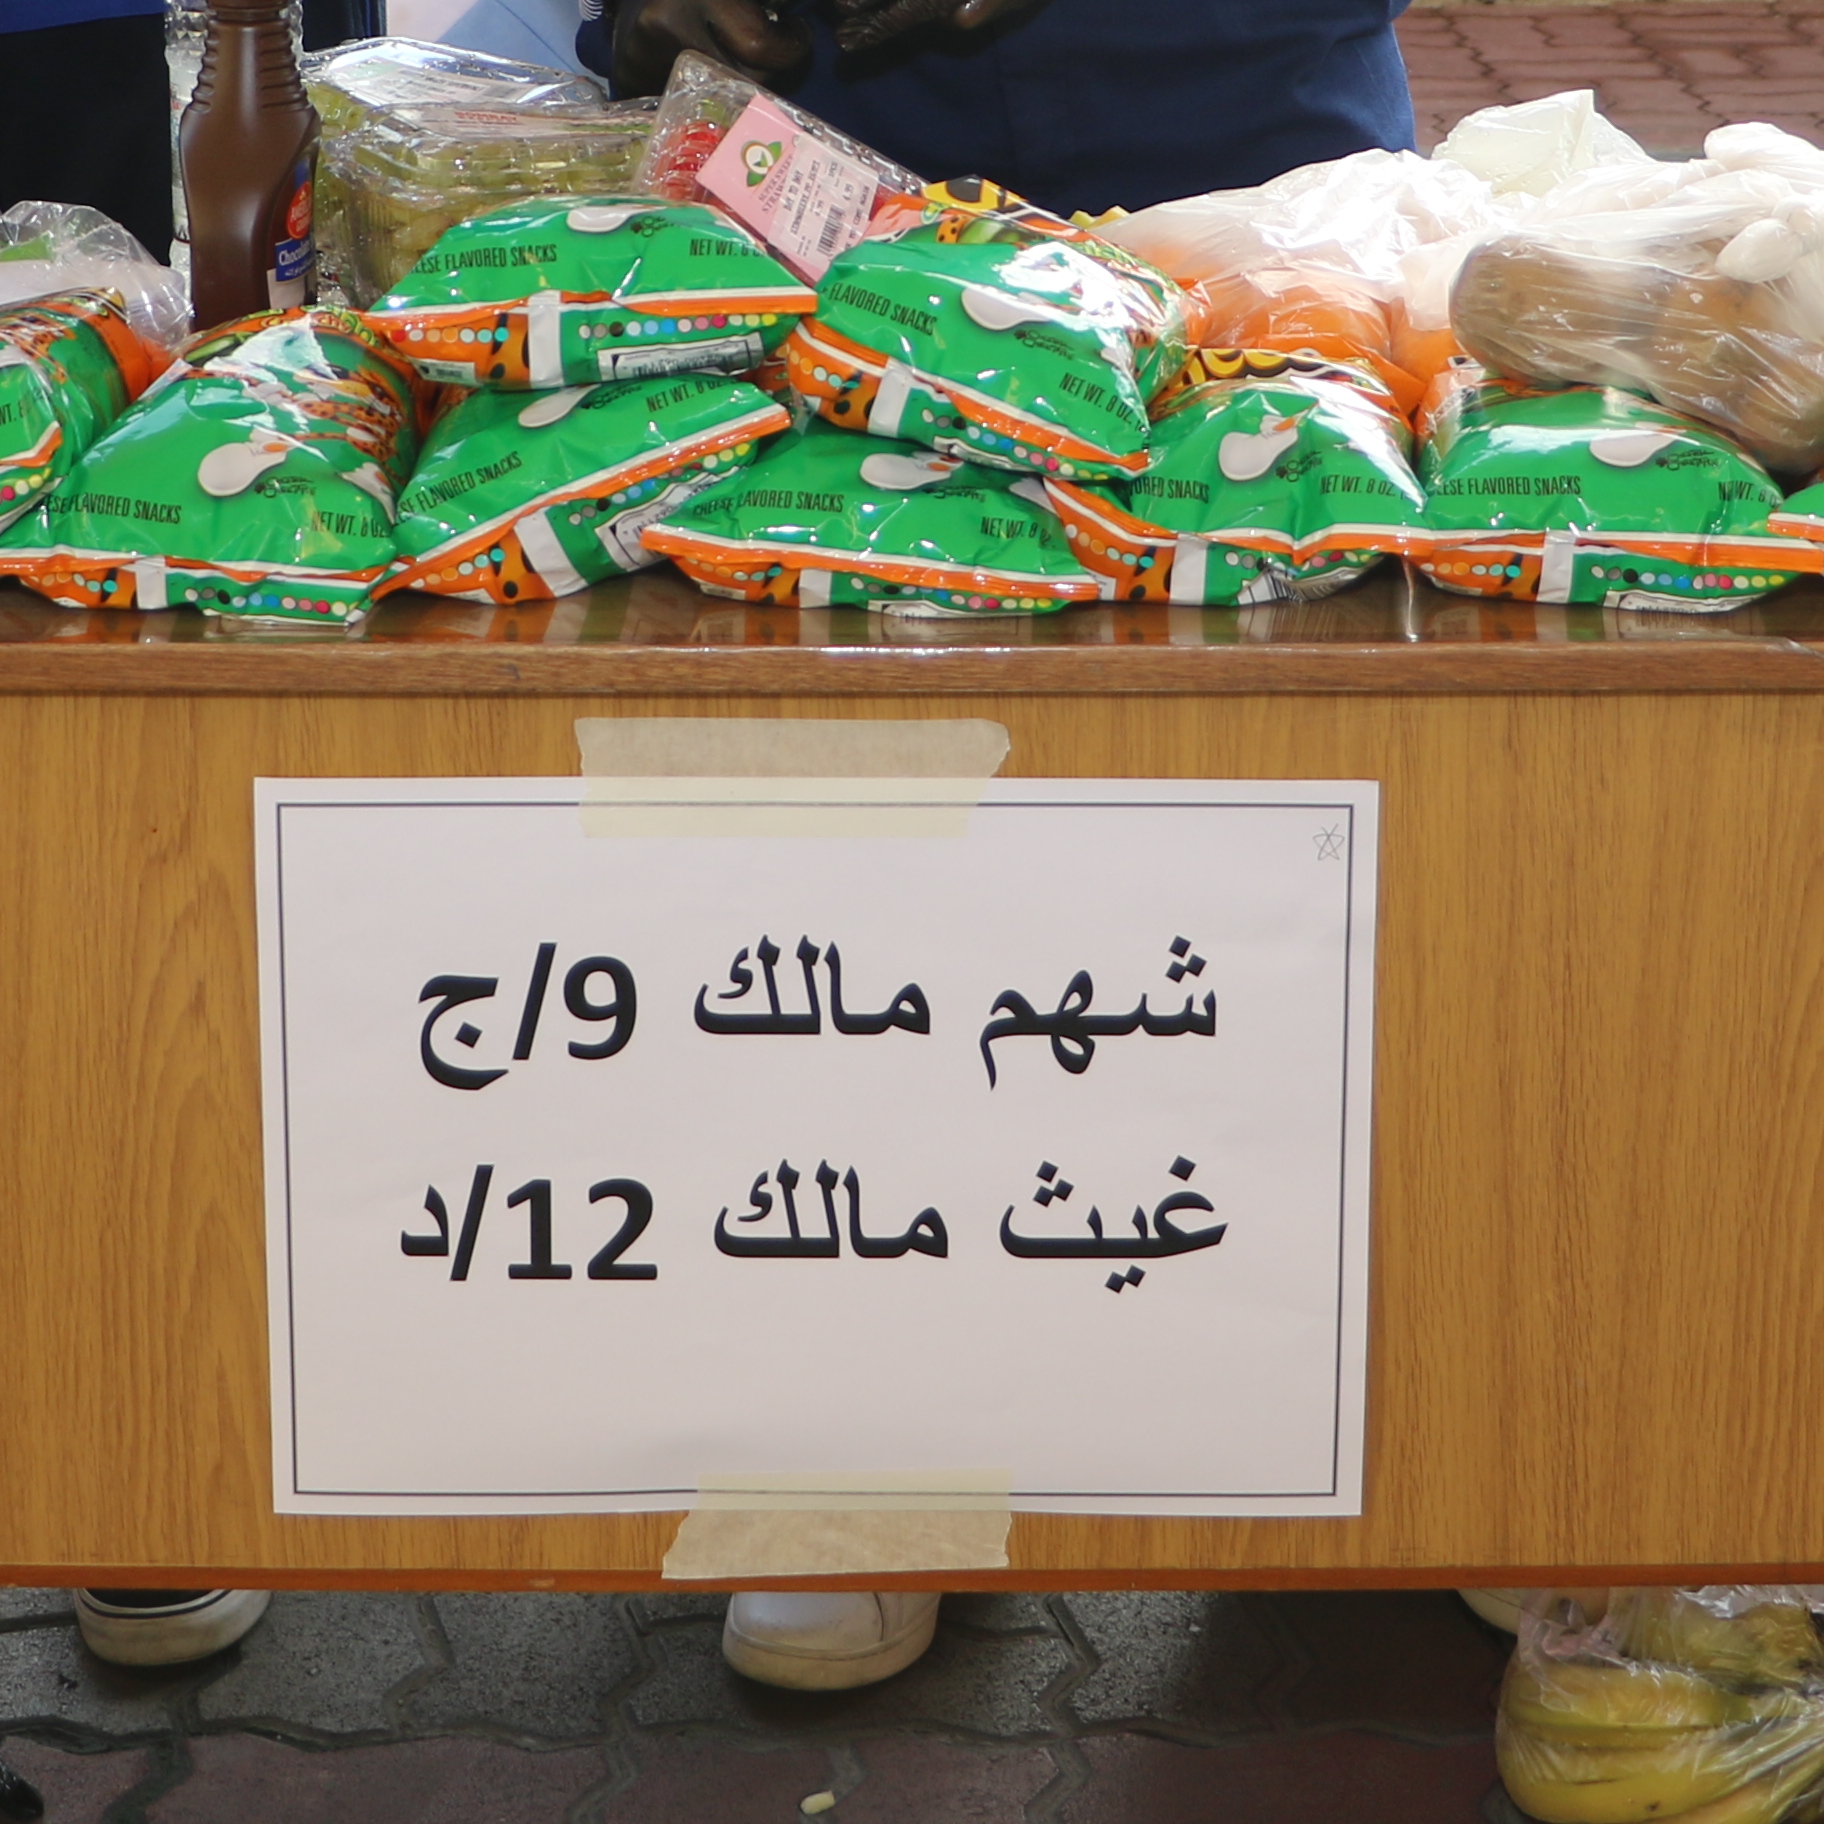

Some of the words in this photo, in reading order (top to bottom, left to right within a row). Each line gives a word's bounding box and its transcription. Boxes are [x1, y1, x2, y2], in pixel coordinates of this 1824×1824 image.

[759, 179, 777, 202] SUPER
[775, 155, 793, 180] SWEET
[445, 247, 506, 269] FLAVORED
[510, 244, 557, 266] SNACKS
[689, 238, 712, 256] NET
[716, 240, 737, 256] WT.
[829, 282, 891, 317] FLAVORED
[890, 303, 938, 336] SNACKS
[646, 390, 669, 413] NET
[669, 383, 695, 404] WT.
[1059, 372, 1086, 396] NET
[1083, 382, 1106, 408] WT.
[1106, 395, 1118, 412] 8
[415, 471, 476, 512] FLAVORED
[476, 451, 523, 484] SNACKS
[1167, 478, 1210, 504] SNACKS
[1321, 474, 1340, 494] NET
[1341, 476, 1362, 493] WT.
[1366, 478, 1375, 494] 8
[1377, 480, 1396, 497] OZ.
[1468, 477, 1530, 495] FLAVORED
[1534, 475, 1581, 496] SNACKS
[1736, 480, 1754, 501] WT.
[68, 493, 130, 517] FLAVORED
[133, 499, 182, 525] SNACKS
[693, 497, 735, 517] CHEESE
[796, 491, 844, 513] SNACKS
[311, 510, 334, 533] NET
[336, 513, 357, 536] WT.
[980, 516, 1004, 538] NET
[1005, 519, 1026, 539] WT.
[1028, 521, 1039, 539] 8
[694, 935, 931, 1036] مالك
[417, 942, 637, 1091] 9/ج
[980, 935, 1215, 1088] شهم
[400, 1164, 658, 1282] 12/د
[714, 1158, 949, 1260] مالك
[1000, 1155, 1229, 1294] غيث
